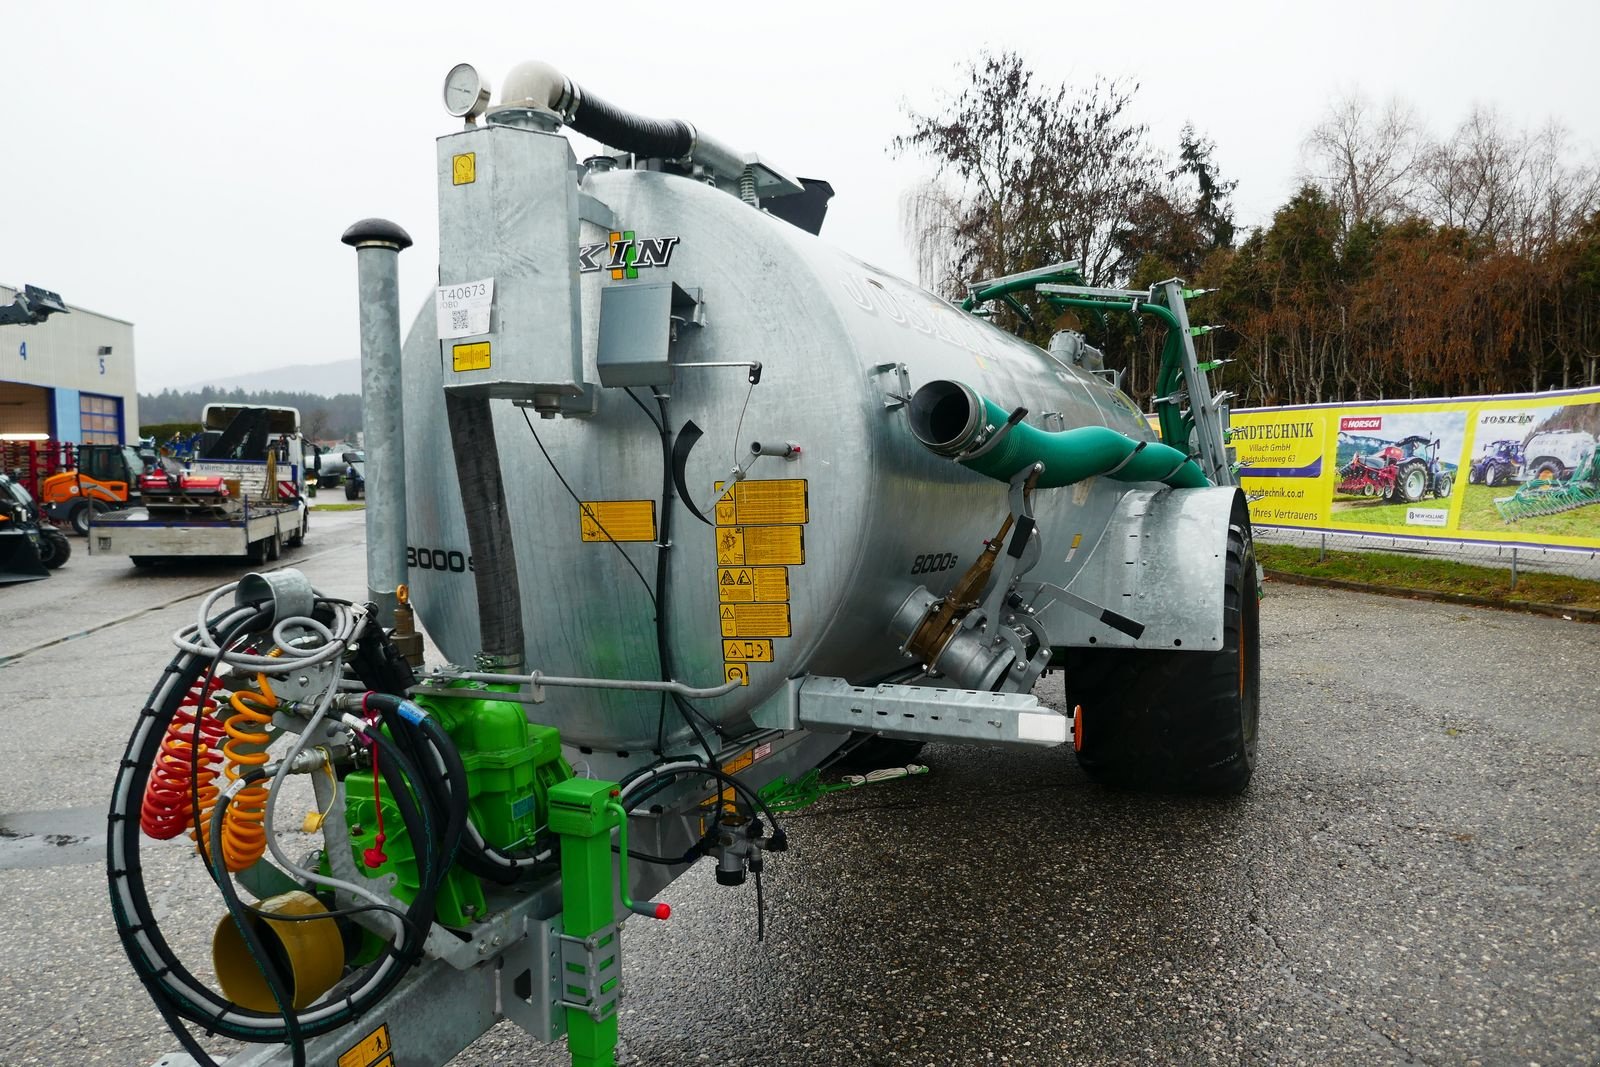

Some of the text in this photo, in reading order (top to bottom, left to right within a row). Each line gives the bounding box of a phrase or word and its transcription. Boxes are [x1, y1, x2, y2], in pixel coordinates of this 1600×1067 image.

[439, 284, 486, 301] T40673
[20, 342, 26, 360] 4
[99, 359, 105, 374] 5
[1348, 419, 1380, 428] HORSCH
[1481, 415, 1535, 425] JOSKIN
[1230, 423, 1314, 440] ANDTECHNIK
[1249, 444, 1291, 452] Villach GmbH
[1287, 455, 1296, 463] 63
[1253, 508, 1272, 518] Ihres
[1274, 509, 1318, 521] Vertrauens
[911, 552, 959, 575] 8000s
